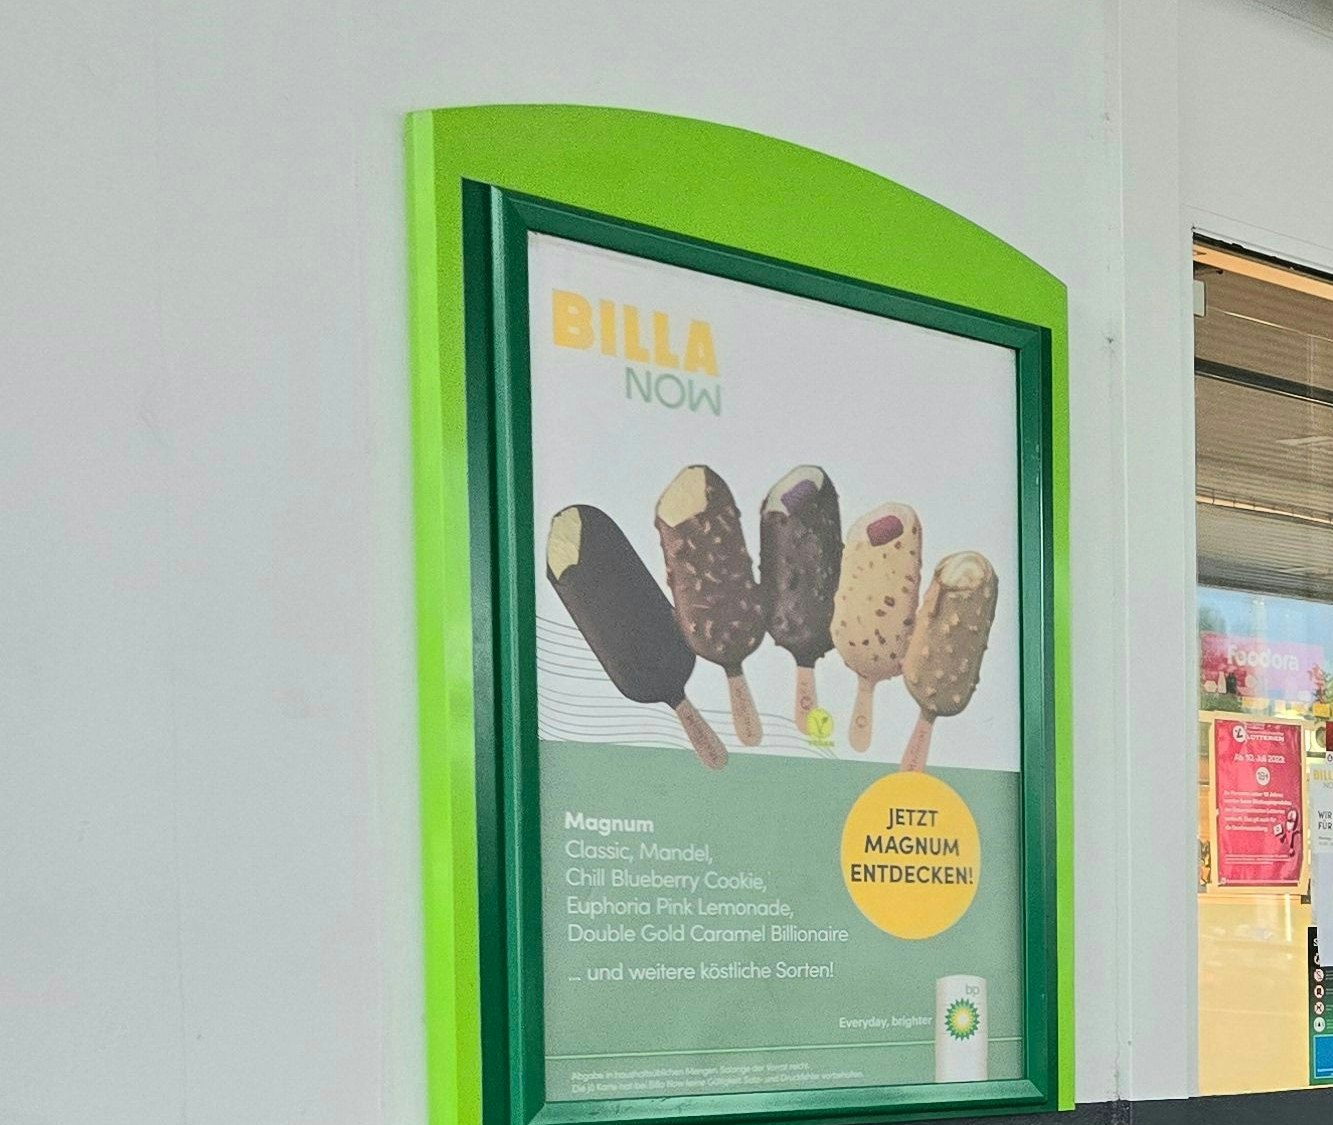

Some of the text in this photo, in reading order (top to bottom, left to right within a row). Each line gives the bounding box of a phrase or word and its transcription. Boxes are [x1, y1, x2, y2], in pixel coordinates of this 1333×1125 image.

[552, 287, 720, 378] BILLA
[625, 366, 721, 417] NOW
[565, 811, 654, 836] Magnum
[886, 808, 938, 830] JETZT
[1318, 810, 1332, 820] WIR
[1318, 819, 1333, 831] FÜR
[565, 840, 713, 865] Classic, Mandel,
[864, 835, 960, 856] MAGNUM
[565, 867, 767, 893] Chill Blueberry Cookie,
[850, 863, 974, 885] ENTDECKEN!
[567, 896, 794, 920] Euphoria Pink Lemonade,
[568, 923, 849, 942] Double Gold Caramel Billionaire
[587, 963, 624, 981] und
[628, 962, 696, 981] weitere
[700, 961, 772, 979] köstliche
[775, 961, 834, 978] Sorten!
[965, 984, 980, 996] bp
[839, 1015, 933, 1030] Everyday, brighter
